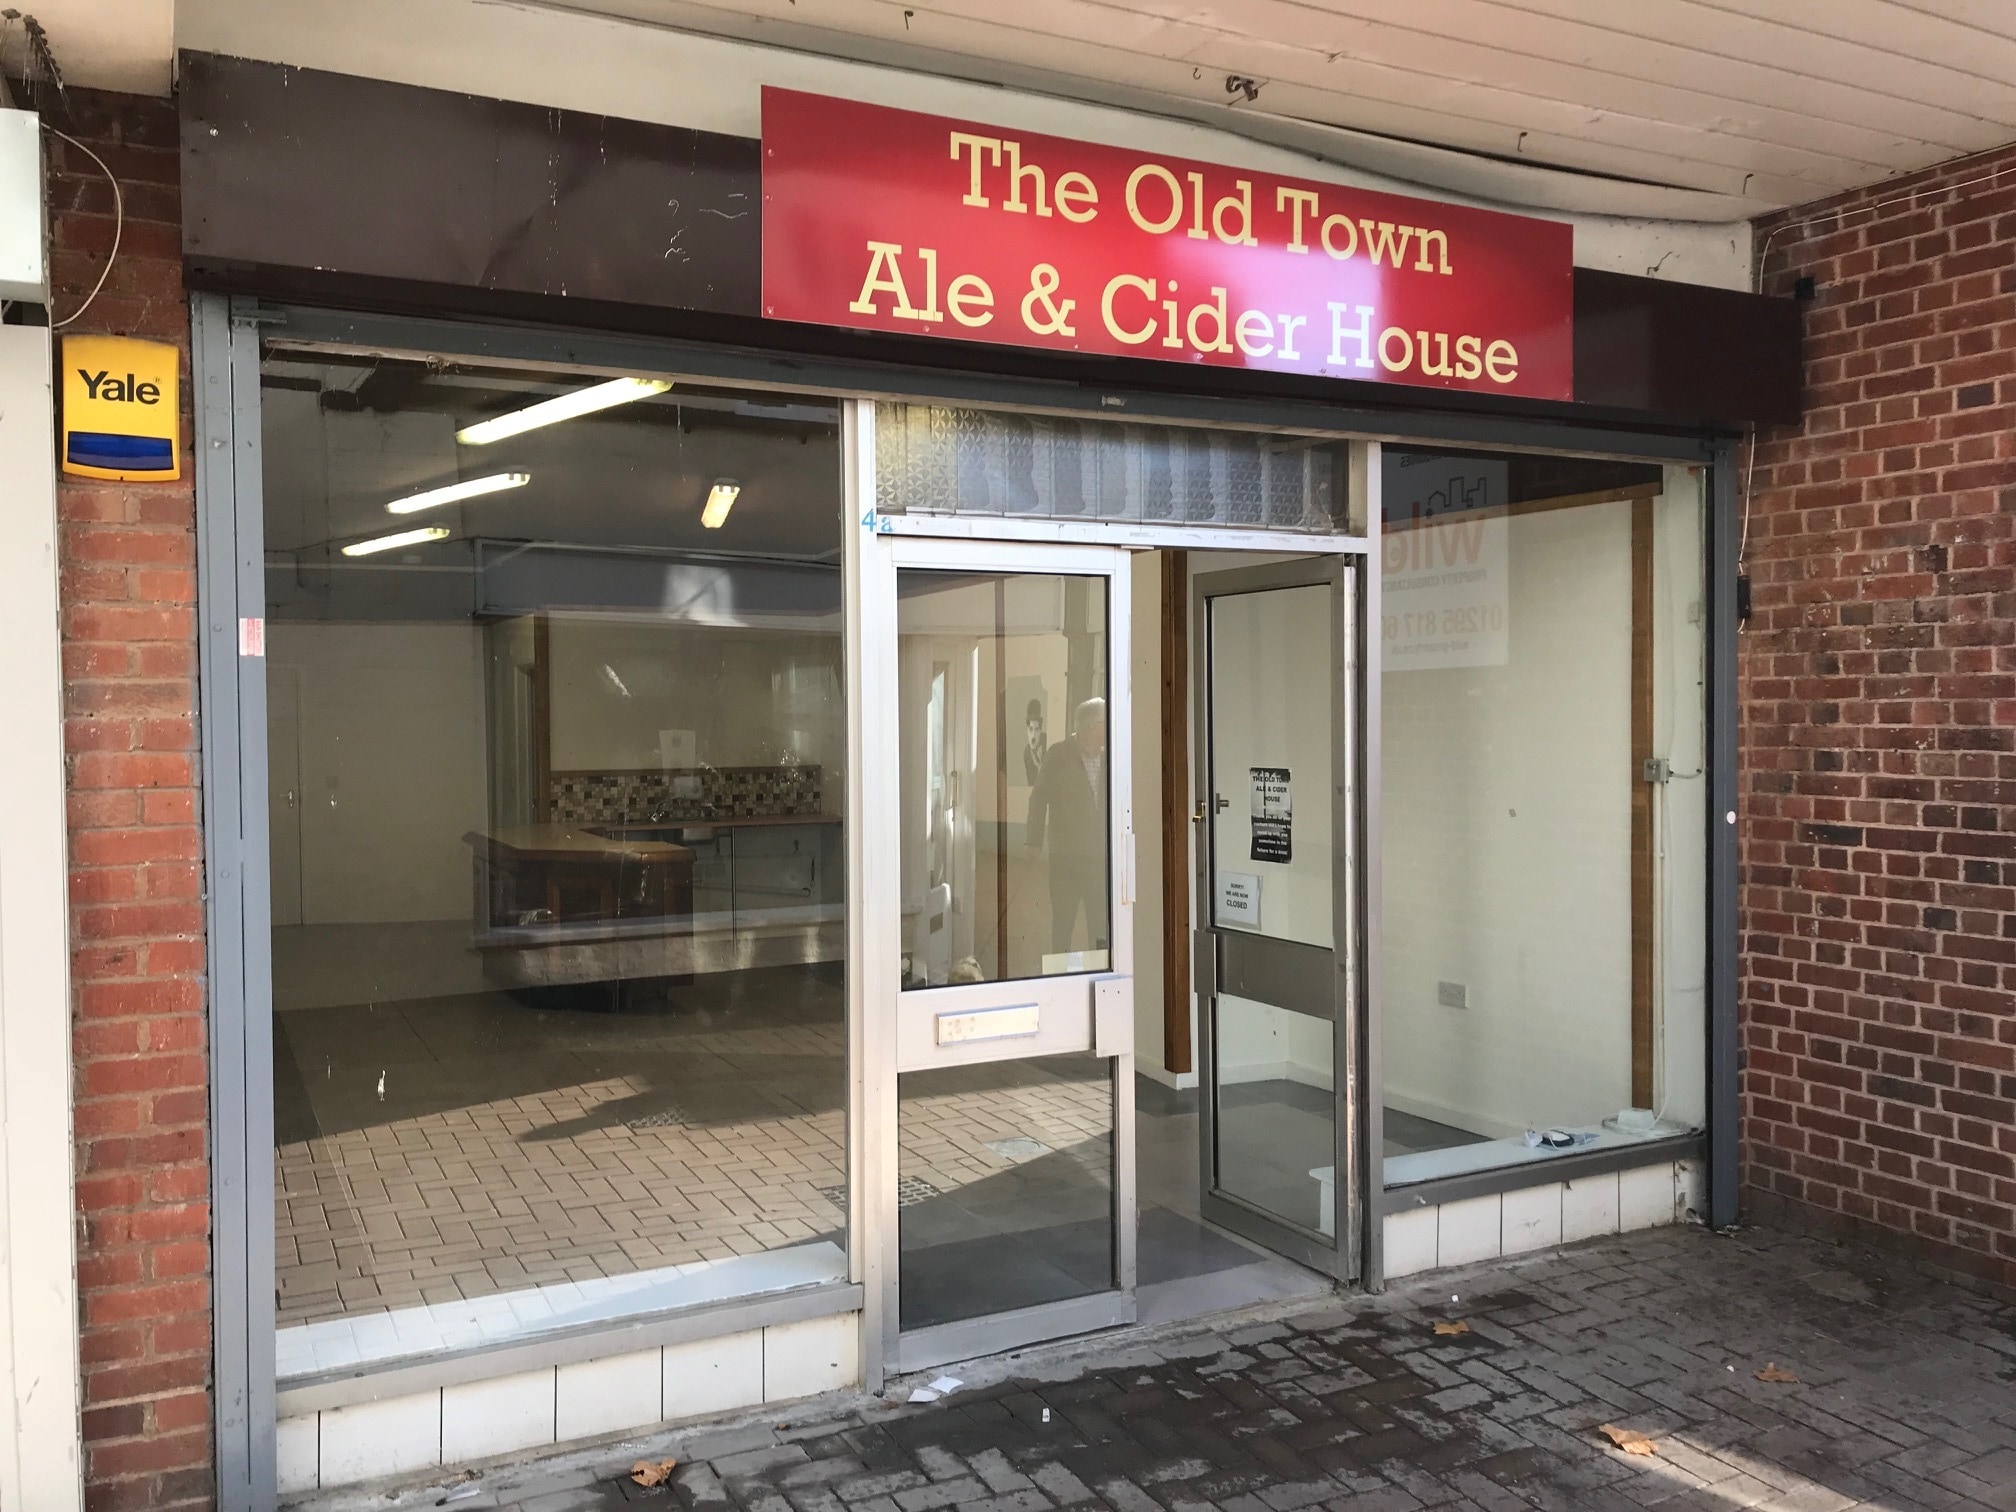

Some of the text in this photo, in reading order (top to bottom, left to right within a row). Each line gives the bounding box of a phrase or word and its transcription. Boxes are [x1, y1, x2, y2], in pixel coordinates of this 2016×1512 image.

[950, 131, 1453, 275] The Old Town
[849, 240, 1519, 384] Ale & Cider House
[77, 368, 160, 405] Yale
[1264, 795, 1280, 803] HOUSE
[1226, 899, 1248, 910] CLOSED
